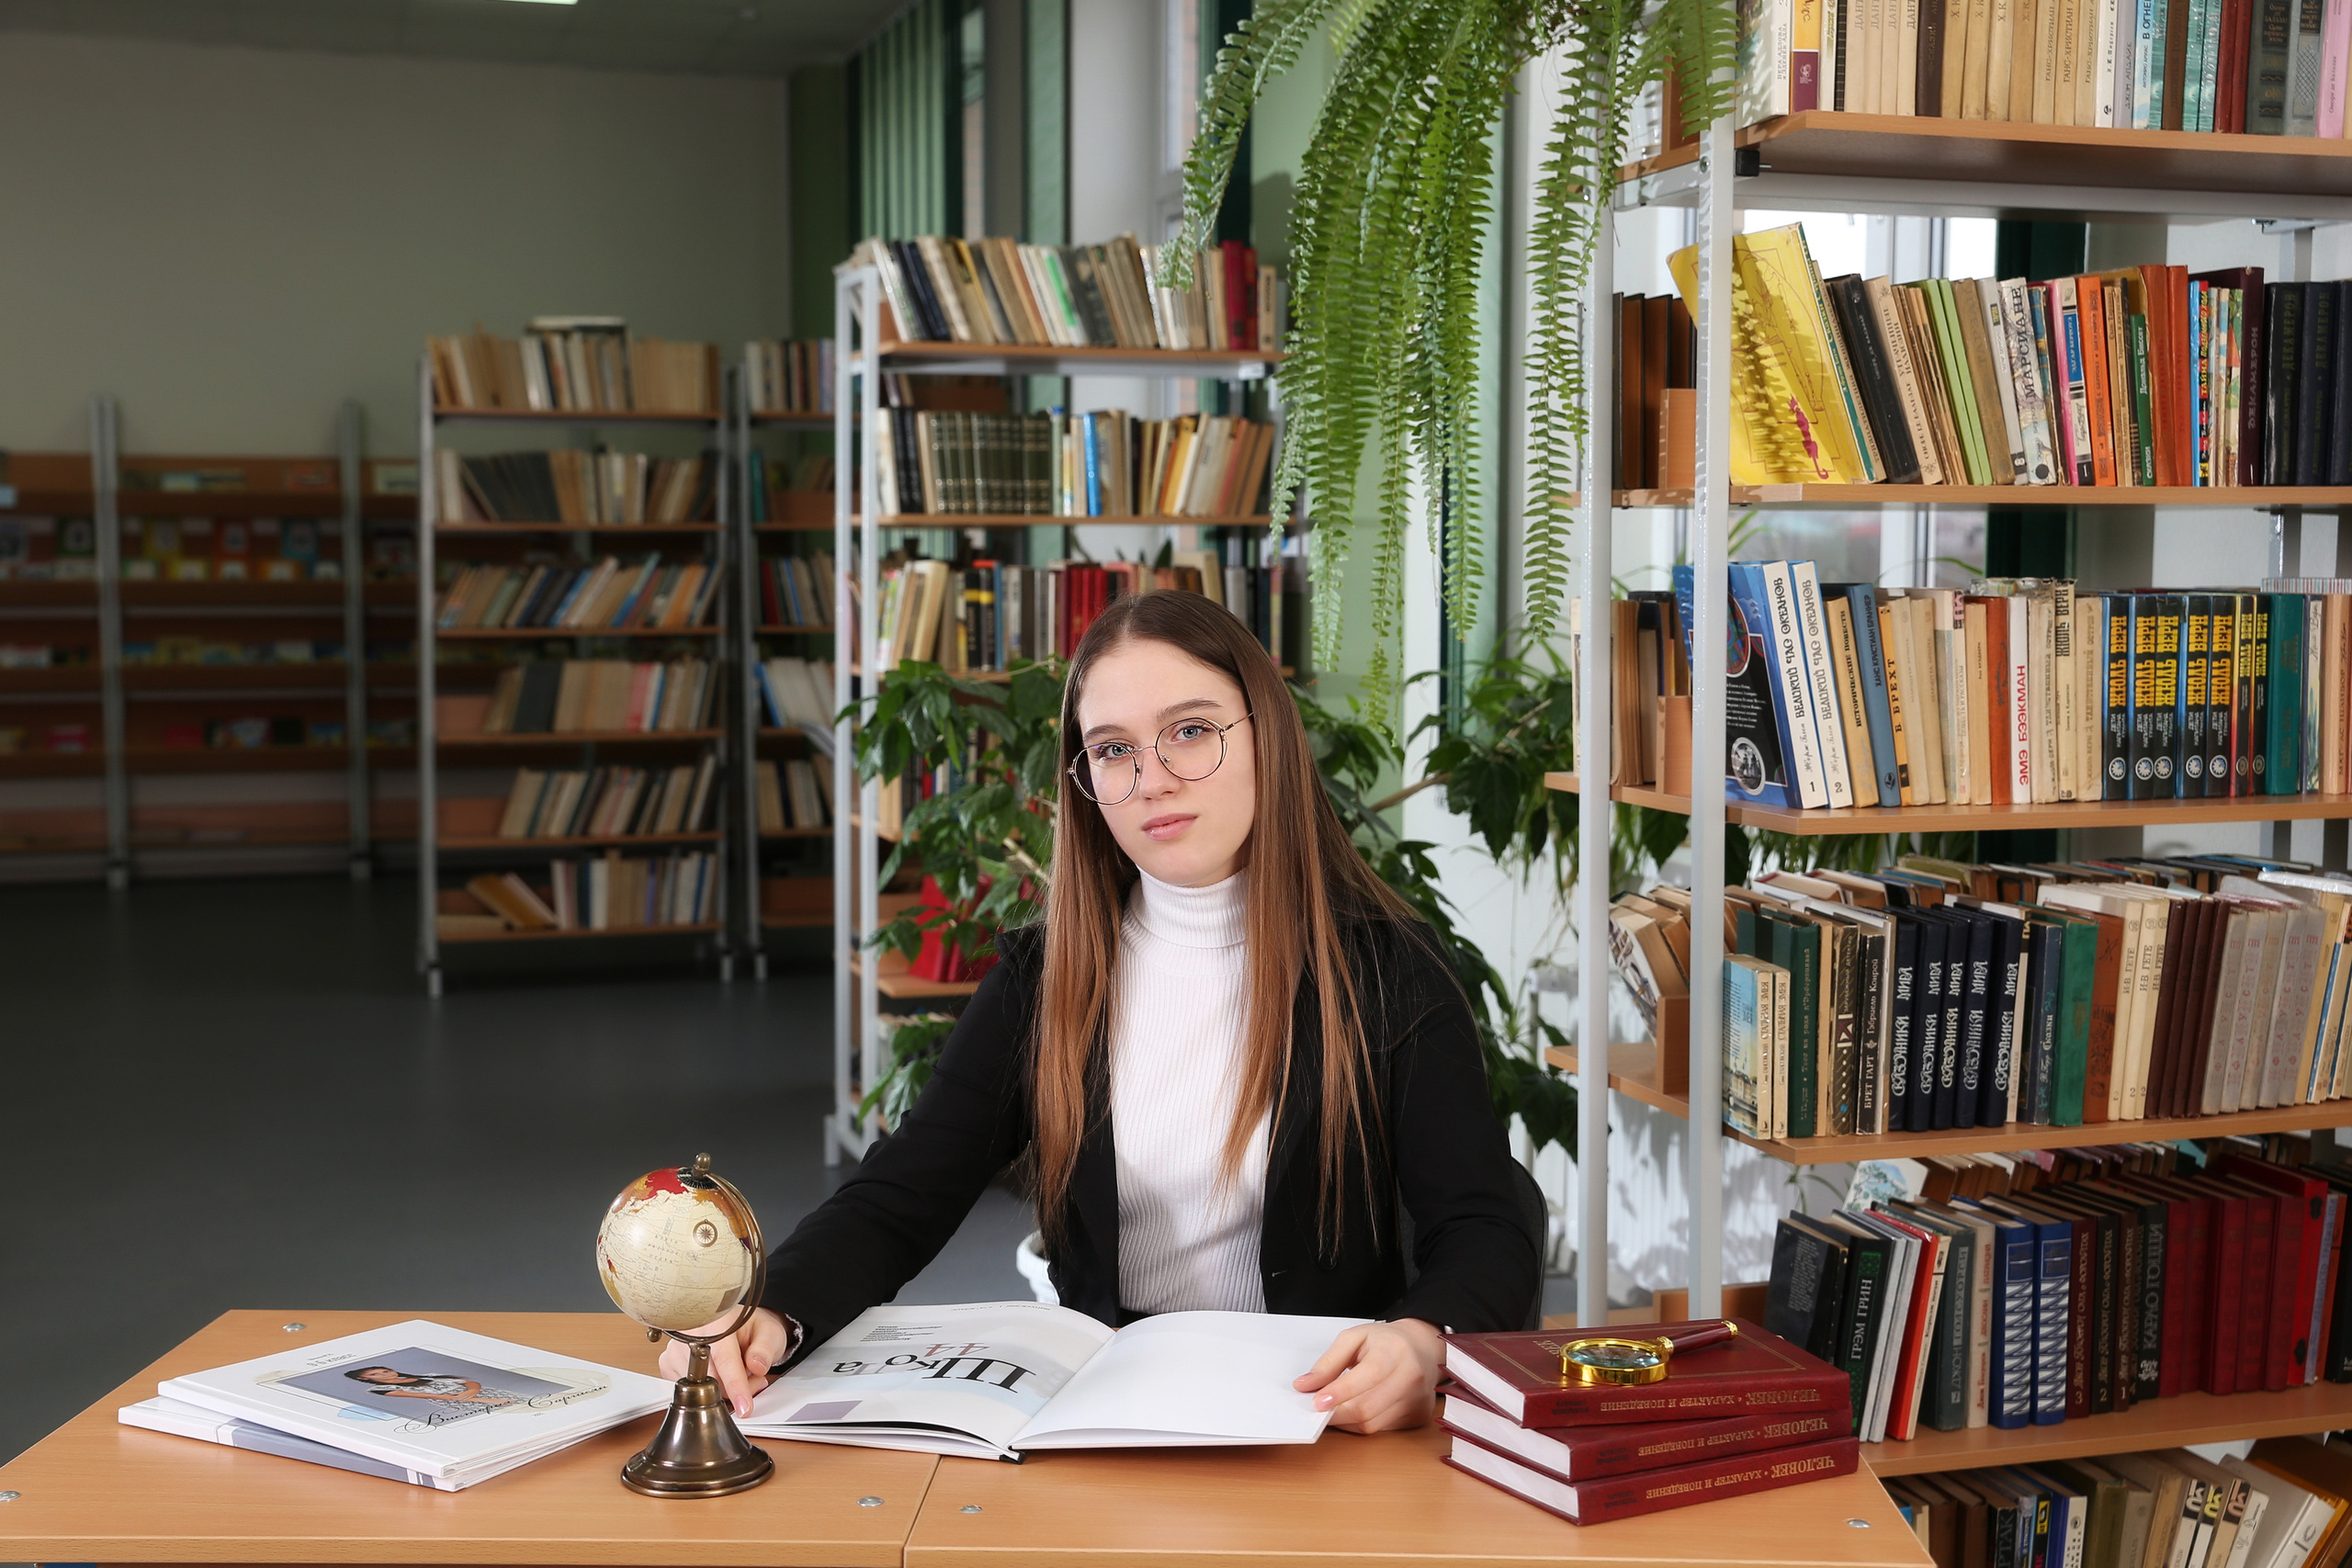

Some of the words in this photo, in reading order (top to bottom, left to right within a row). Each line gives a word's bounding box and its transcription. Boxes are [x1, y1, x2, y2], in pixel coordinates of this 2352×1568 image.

[2044, 6, 2055, 82] ГАНС-ХРИСТИАН
[2063, 7, 2074, 84] ГАНС-ХРИСТИАН
[2084, 8, 2095, 84] ГАНС-ХРИСТИАН
[2143, 32, 2151, 40] В
[2123, 41, 2132, 81] АПДАЙК
[2200, 290, 2210, 310] ХОДА
[2010, 286, 2037, 400] МАРСИАНЕ
[2067, 316, 2075, 349] БЕРРОУЗ
[2136, 325, 2145, 356] Биссет
[2199, 310, 2210, 357] ПОДЗЕМНОГО
[2282, 293, 2297, 371] ДЕКАМЕРОН
[2314, 291, 2330, 369] ДЕКАМЕРОН
[2069, 348, 2077, 373] ЭДГАР
[2138, 357, 2148, 395] Дональд
[2199, 358, 2209, 397] ТАЙНА
[2246, 326, 2259, 430] ДЕКАМЕРОН
[1905, 379, 1920, 421] БАЛЬЗАК
[2013, 456, 2026, 467] 8
[2143, 446, 2154, 479] СКАЗКИ
[1772, 577, 1792, 635] ОКЕАНОВ
[1801, 579, 1819, 637] ОКЕАНОВ
[1863, 594, 1875, 628] БРАННЕР
[2054, 588, 2070, 617] ВЕРН
[1838, 610, 1850, 652] ПОВЕСТИ
[2054, 621, 2071, 658] ЖЮЛЬ
[2109, 615, 2127, 654] ВЕРН
[2135, 615, 2156, 654] ВЕРН
[2155, 615, 2179, 654] ВЕРН
[2188, 615, 2209, 653] ВЕРН
[2211, 615, 2233, 653] ВЕРН
[2240, 613, 2253, 640] ВЕРН
[2256, 613, 2267, 639] ВЕРН
[1782, 637, 1796, 664] ЧАС
[1810, 640, 1824, 665] ЧАС
[1868, 627, 1881, 667] КРИСТИАН
[2239, 643, 2252, 678] ЖЮЛЬ
[2255, 643, 2267, 677] ЖЮЛЬ
[1787, 666, 1806, 719] ВЕЛИКИЙ
[1813, 668, 1832, 721] ВЕЛИКИЙ
[1846, 654, 1862, 728] ИСТОРИЧЕСКИЕ
[1872, 666, 1883, 688] ХАНС
[1887, 658, 1901, 715] БРЕХТ
[2084, 648, 2095, 722] ТАИНСТВЕННЫЙ
[2109, 659, 2127, 707] ЖЮЛЬ
[2134, 659, 2155, 708] ЖЮЛЬ
[2154, 658, 2177, 707] ЖЮЛЬ
[2187, 658, 2207, 706] ЖЮЛЬ
[2211, 658, 2231, 706] ЖЮЛЬ
[2016, 664, 2029, 743] БЭЭКМАН
[2018, 749, 2030, 786] ЭМЭ
[1809, 781, 1815, 793] 1
[1834, 781, 1844, 794] 2
[1843, 935, 1854, 967] ДЕТЕКТИВ
[2124, 947, 2135, 973] ГЕТЕ
[2154, 943, 2165, 970] ГЕТЕ
[1760, 981, 1769, 1001] ЗМЕЯ
[1778, 982, 1786, 1002] ЗМЕЯ
[1842, 968, 1850, 1013] ЗАРУБЕЖНЫЙ
[1868, 958, 1880, 993] Конрой
[1895, 966, 1913, 1001] МИРА
[1928, 961, 1942, 995] МИРА
[1948, 962, 1963, 996] МИРА
[1971, 961, 1988, 995] МИРА
[1759, 1003, 1770, 1041] СТАЛЬНАЯ
[1777, 1004, 1786, 1041] СТАЛЬНАЯ
[1995, 1010, 2013, 1091] СКАЗОЧНИКИ
[2004, 962, 2018, 997] МИРА
[2041, 1014, 2054, 1051] Сказки
[2129, 1087, 2136, 1099] 2
[2141, 944, 2153, 971] ГЕТЕ
[2232, 964, 2254, 1070] ФАУСТ
[2272, 963, 2294, 1066] ФАУСТ
[2289, 962, 2311, 1066] ФАУСТ
[1890, 1015, 1910, 1097] СКАЗОЧНИКИ
[1919, 1013, 1938, 1094] СКАЗОЧНИКИ
[1940, 1007, 1959, 1088] СКАЗОЧНИКИ
[1962, 1010, 1984, 1090] СКАЗОЧНИКИ
[1864, 1055, 1874, 1079] ГАРТ
[1863, 1083, 1872, 1110] БРЕТ
[2078, 1231, 2089, 1283] ФОРСАЙТАХ
[2102, 1229, 2113, 1280] ФОРСАЙТАХ
[2144, 1222, 2164, 1290] ГОЦЦИ
[1856, 1278, 1872, 1318] ГРИН
[1953, 1247, 1968, 1346] ГОЛСУОРСИ
[2078, 1291, 2086, 1312] САГА
[2101, 1287, 2109, 1308] САГА
[2120, 1386, 2126, 1400] 1
[2124, 1226, 2133, 1278] ФОРСАЙТАХ
[2143, 1292, 2159, 1350] КАРЛО
[924, 1343, 990, 1358] 44
[1849, 1322, 1865, 1360] ГРЭМ
[832, 1355, 1036, 1394] Школа
[1951, 1346, 1962, 1389] ДЖОН
[1600, 1398, 1666, 1412] ПОВЕДЕНИЕ
[1668, 1398, 1677, 1409] И
[1679, 1394, 1736, 1408] ХАРАКТЕР
[1745, 1388, 1821, 1406] ЧЕЛОВЕК
[2075, 1391, 2083, 1404] 3
[2099, 1387, 2108, 1403] 2
[392, 1399, 521, 1435] Виктория
[1763, 1416, 1829, 1439] ЧЕЛОВЕК
[1637, 1438, 1695, 1457] ПОВЕДЕНИЕ
[1696, 1437, 1705, 1448] И
[1706, 1429, 1756, 1447] ХАРАКТЕР
[1704, 1478, 1713, 1490] И
[1713, 1469, 1762, 1489] ХАРАКТЕР
[1770, 1454, 1836, 1480] ЧЕЛОВЕК
[1645, 1480, 1703, 1500] ПОВЕДЕНИЕ
